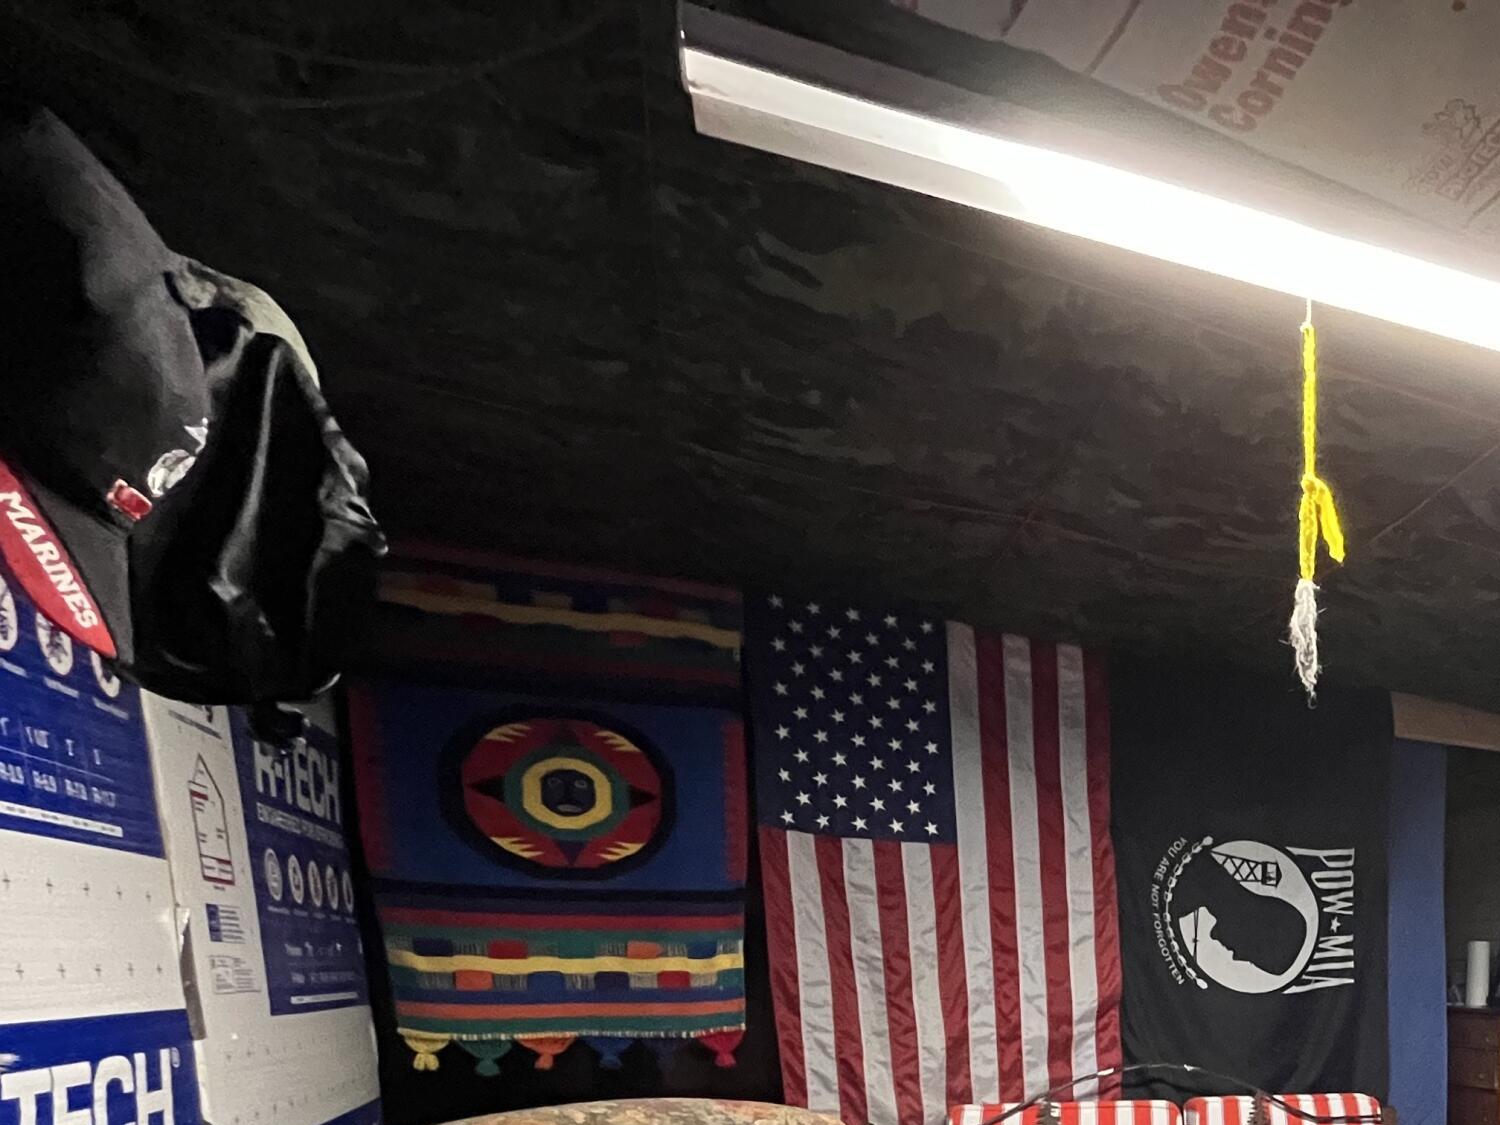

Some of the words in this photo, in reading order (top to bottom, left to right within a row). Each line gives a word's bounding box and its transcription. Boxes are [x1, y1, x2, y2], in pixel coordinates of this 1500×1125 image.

[1157, 0, 1278, 112] Owen
[1208, 0, 1352, 132] Cornin
[0, 491, 99, 629] MARINES
[1153, 856, 1170, 881] ARE
[1167, 837, 1187, 858] YOU
[1285, 846, 1355, 916] POW
[1151, 883, 1161, 908] NOT
[1152, 912, 1186, 985] FORGOTTEN
[1281, 934, 1355, 995] MIA
